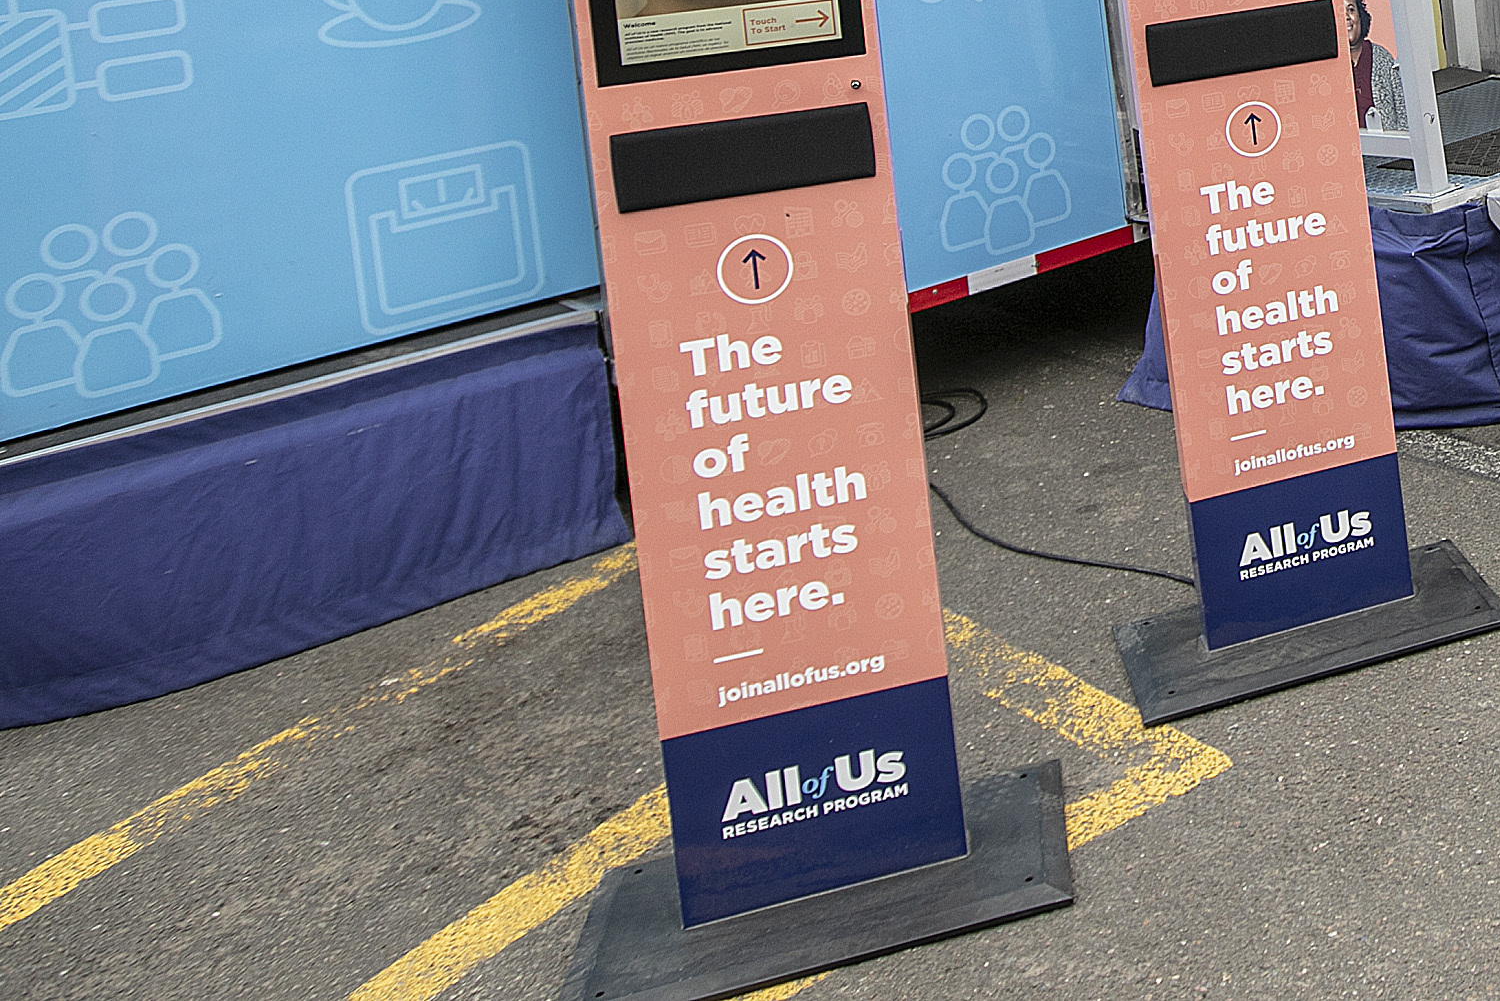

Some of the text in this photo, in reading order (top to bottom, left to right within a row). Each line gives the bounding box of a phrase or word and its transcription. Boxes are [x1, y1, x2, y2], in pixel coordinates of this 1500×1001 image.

[623, 20, 656, 29] Welcome
[749, 16, 777, 26] Touch
[750, 23, 786, 35] To Start
[1200, 180, 1275, 215] The
[1205, 212, 1327, 256] future
[1211, 260, 1252, 295] of
[1215, 285, 1339, 336] health
[679, 334, 783, 376] The
[1221, 331, 1333, 376] starts
[685, 374, 852, 429] future
[1225, 375, 1325, 416] here.
[693, 433, 750, 478] of
[1234, 435, 1356, 477] joinallofus.org
[698, 465, 867, 531] health
[703, 522, 859, 581] starts
[1239, 509, 1372, 567] All of Us
[1240, 536, 1375, 581] RESEARCH PROGRAM
[709, 581, 845, 631] here.
[718, 653, 885, 708] joinallofus.org
[721, 749, 906, 823] All of Us
[722, 783, 909, 840] RESEARCH PROGRAM
